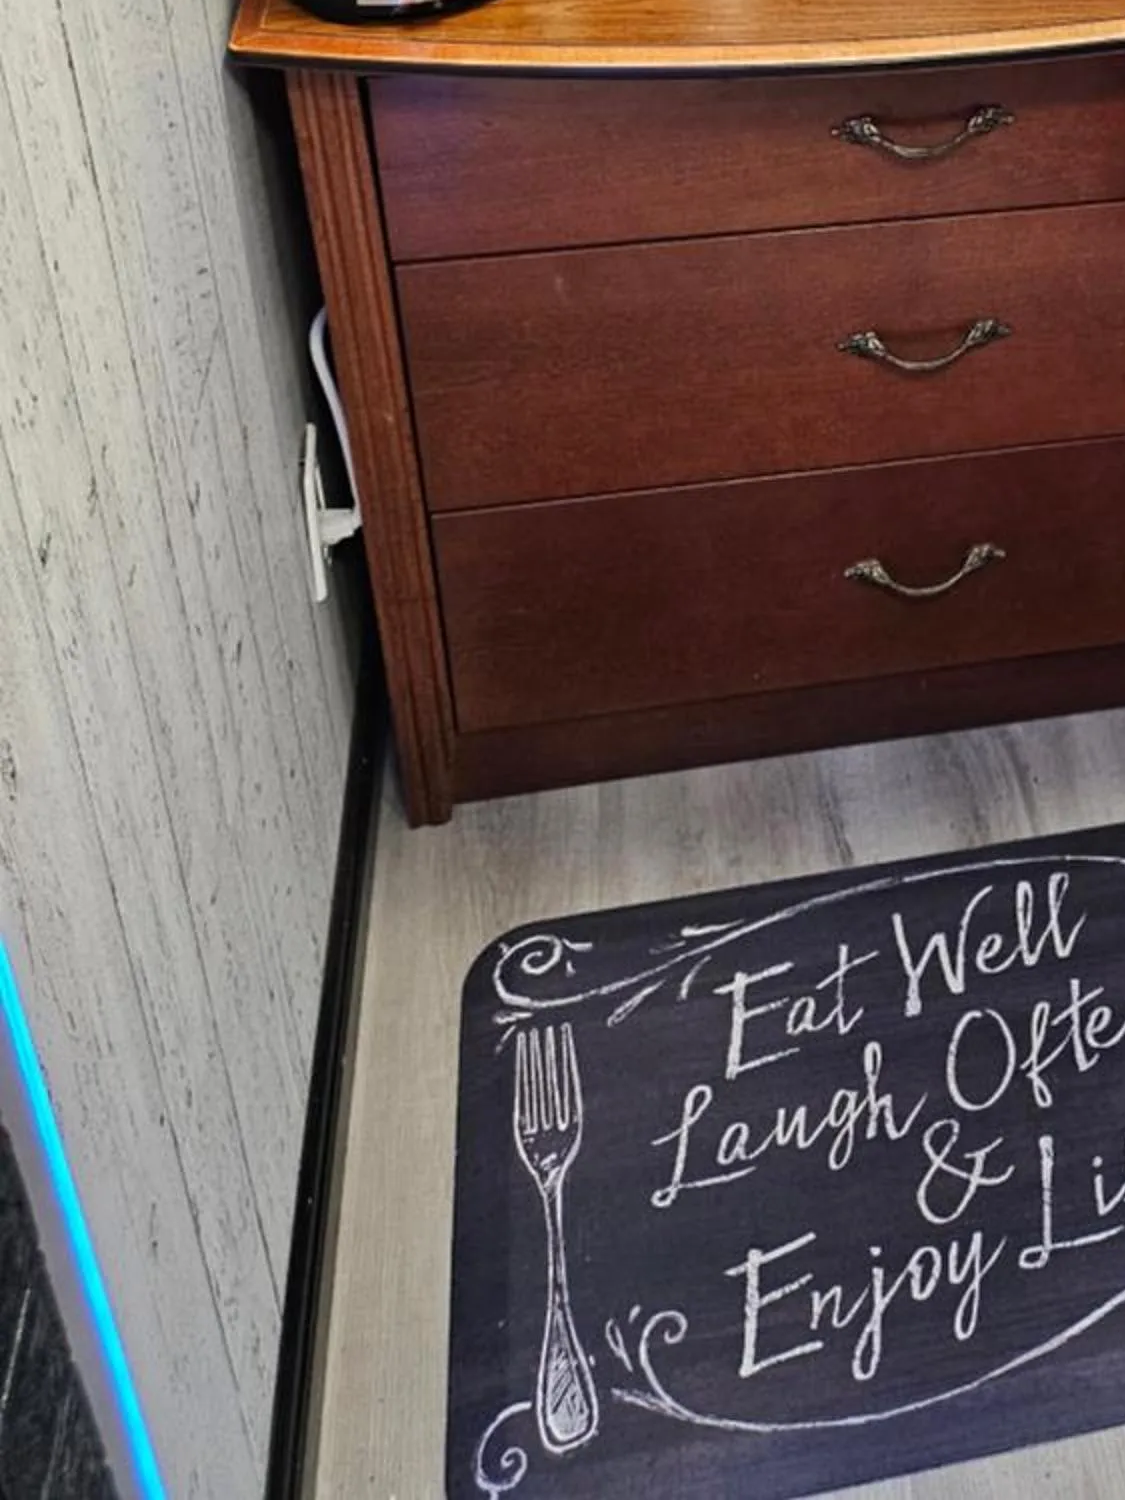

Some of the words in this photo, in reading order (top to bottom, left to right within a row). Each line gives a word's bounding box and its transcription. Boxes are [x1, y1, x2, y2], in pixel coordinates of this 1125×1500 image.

[716, 946, 878, 1080] Eat
[890, 872, 1086, 1019] Well
[652, 1042, 928, 1208] Laugh
[917, 1120, 1013, 1225] &
[724, 1231, 1009, 1380] Enjoy
